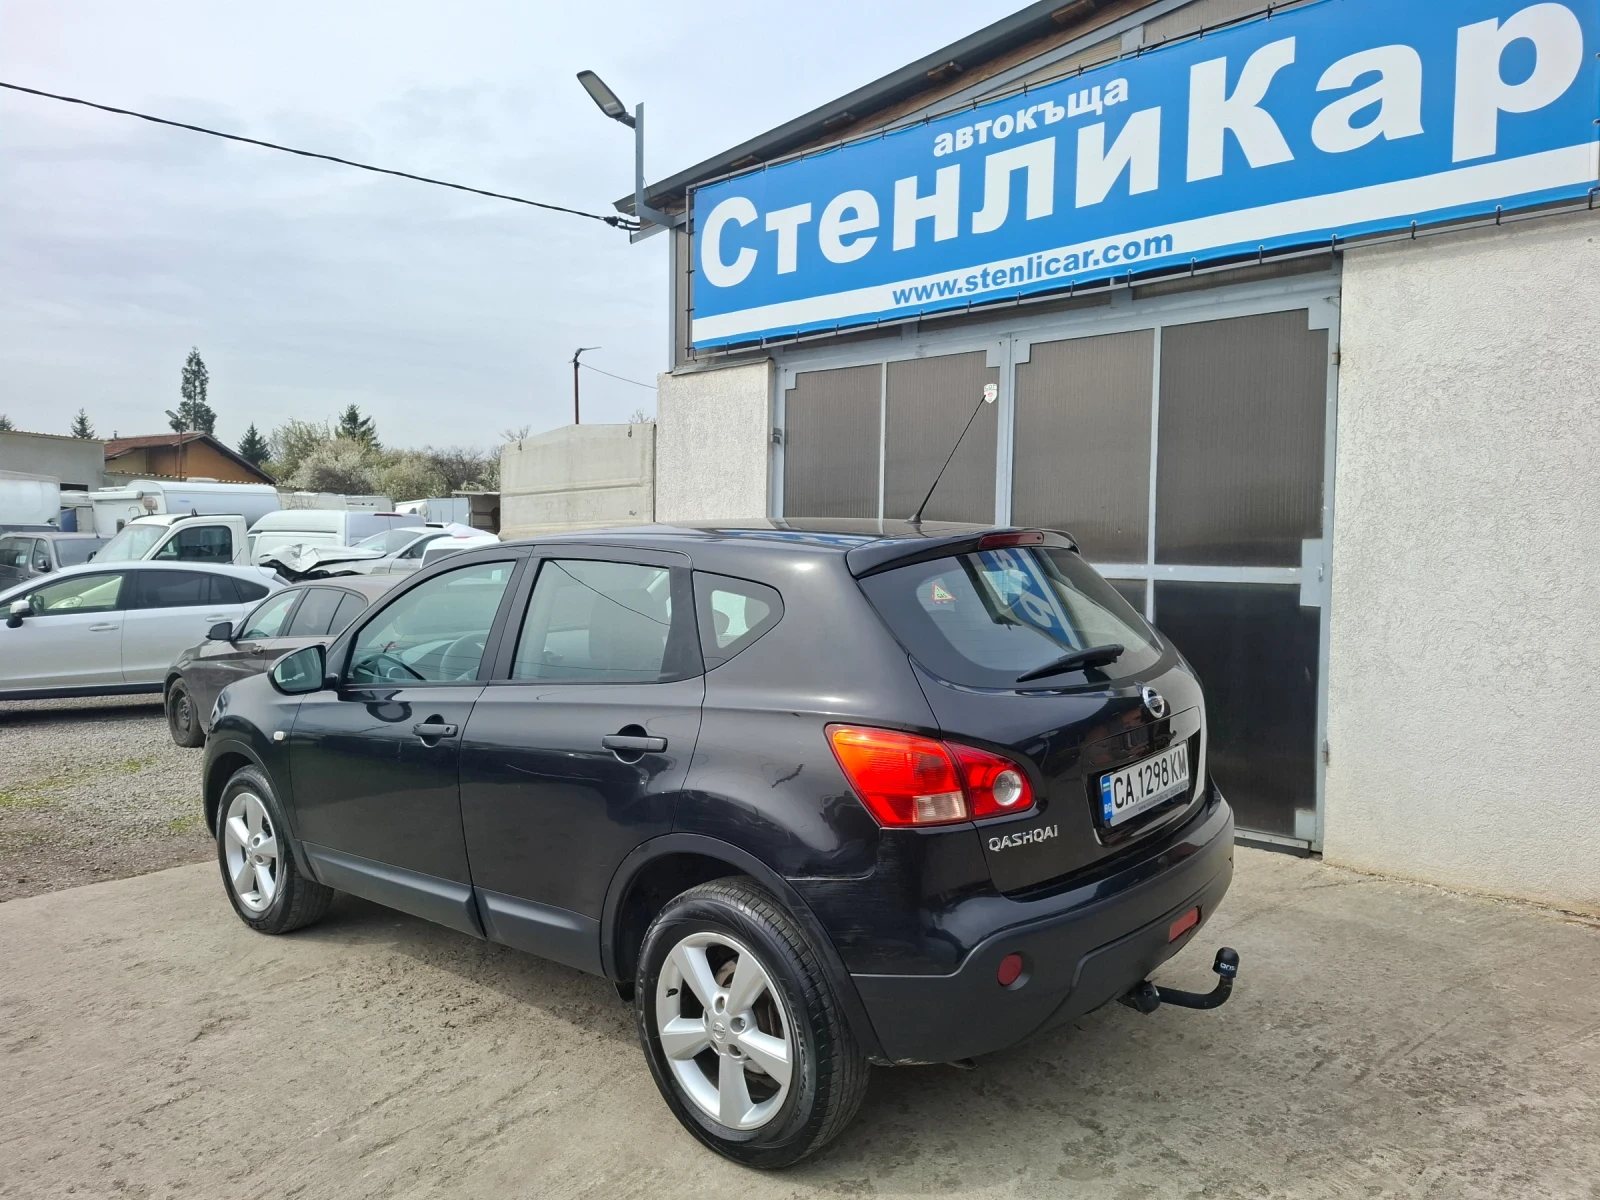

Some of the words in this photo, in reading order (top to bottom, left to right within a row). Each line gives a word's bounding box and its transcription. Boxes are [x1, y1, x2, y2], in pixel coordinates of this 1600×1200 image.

[700, 2, 1584, 288] СтенлиКар
[933, 77, 1129, 158] автокъща
[892, 234, 1173, 306] www.stenlicar.com
[988, 824, 1059, 852] QASHQAI
[1104, 803, 1112, 814] BG
